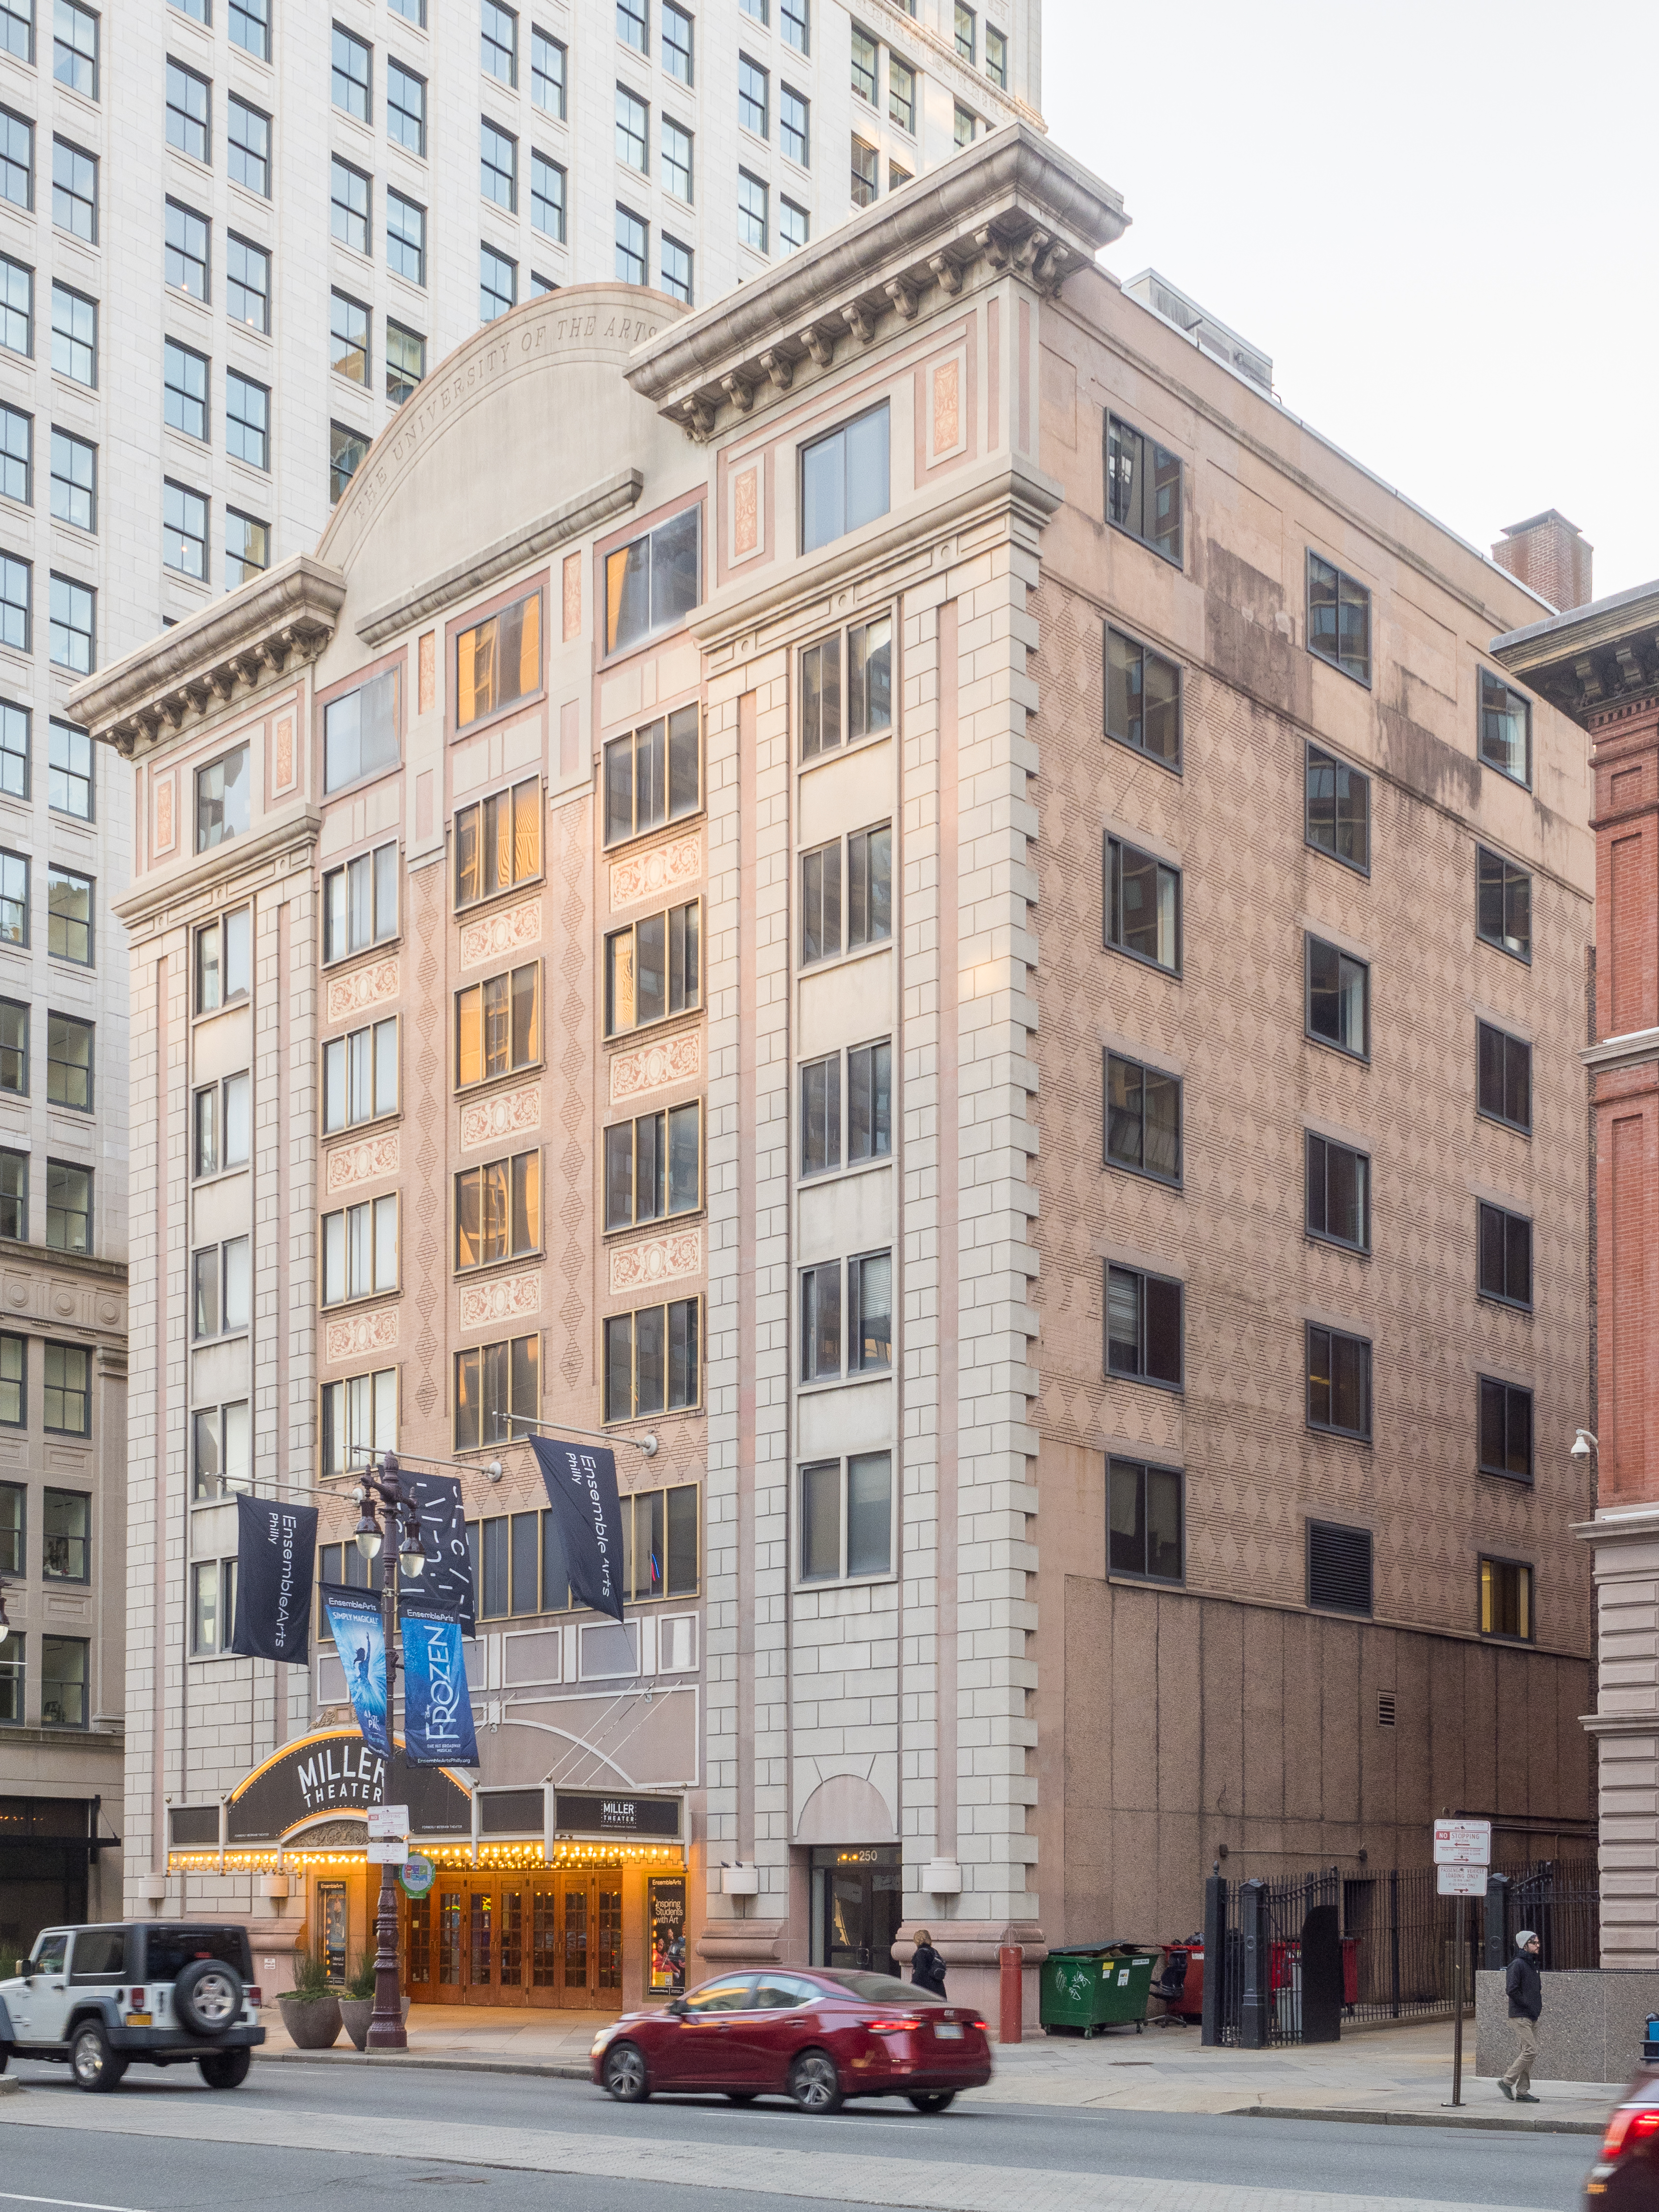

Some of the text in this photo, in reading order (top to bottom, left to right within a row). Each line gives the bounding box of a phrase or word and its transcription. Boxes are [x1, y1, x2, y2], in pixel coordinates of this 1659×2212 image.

[353, 315, 658, 519] THE UNIVERSITY OF THE ARTS
[565, 1452, 582, 1485] Philly
[267, 1512, 279, 1545] Philly
[275, 1514, 297, 1648] EnsembleArts
[328, 1597, 377, 1611] EnsembleArts
[332, 1612, 353, 1620] SIMPLY
[407, 1609, 454, 1622] EnsembleArts
[423, 1625, 460, 1741] FROZEN
[304, 1782, 382, 1808] THEATER
[603, 1803, 634, 1814] MILLER
[859, 1850, 877, 1861] 250
[656, 1899, 681, 1909] Inspiring
[656, 1906, 683, 1916] Students
[669, 1915, 679, 1924] Art
